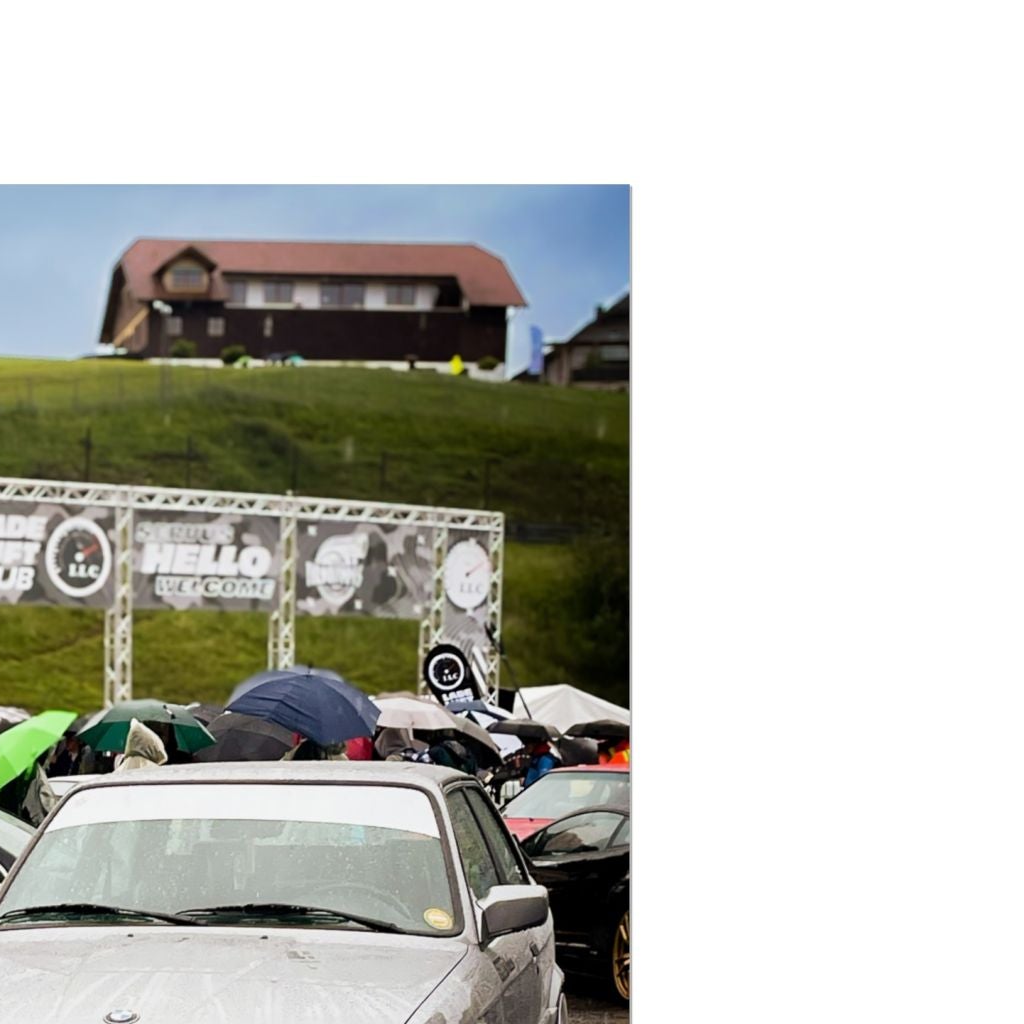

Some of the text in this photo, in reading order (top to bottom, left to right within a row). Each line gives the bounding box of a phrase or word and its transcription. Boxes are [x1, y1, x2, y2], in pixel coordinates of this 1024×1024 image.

[68, 562, 100, 579] LLC
[141, 542, 272, 578] HELLO
[155, 575, 275, 600] WELCOME
